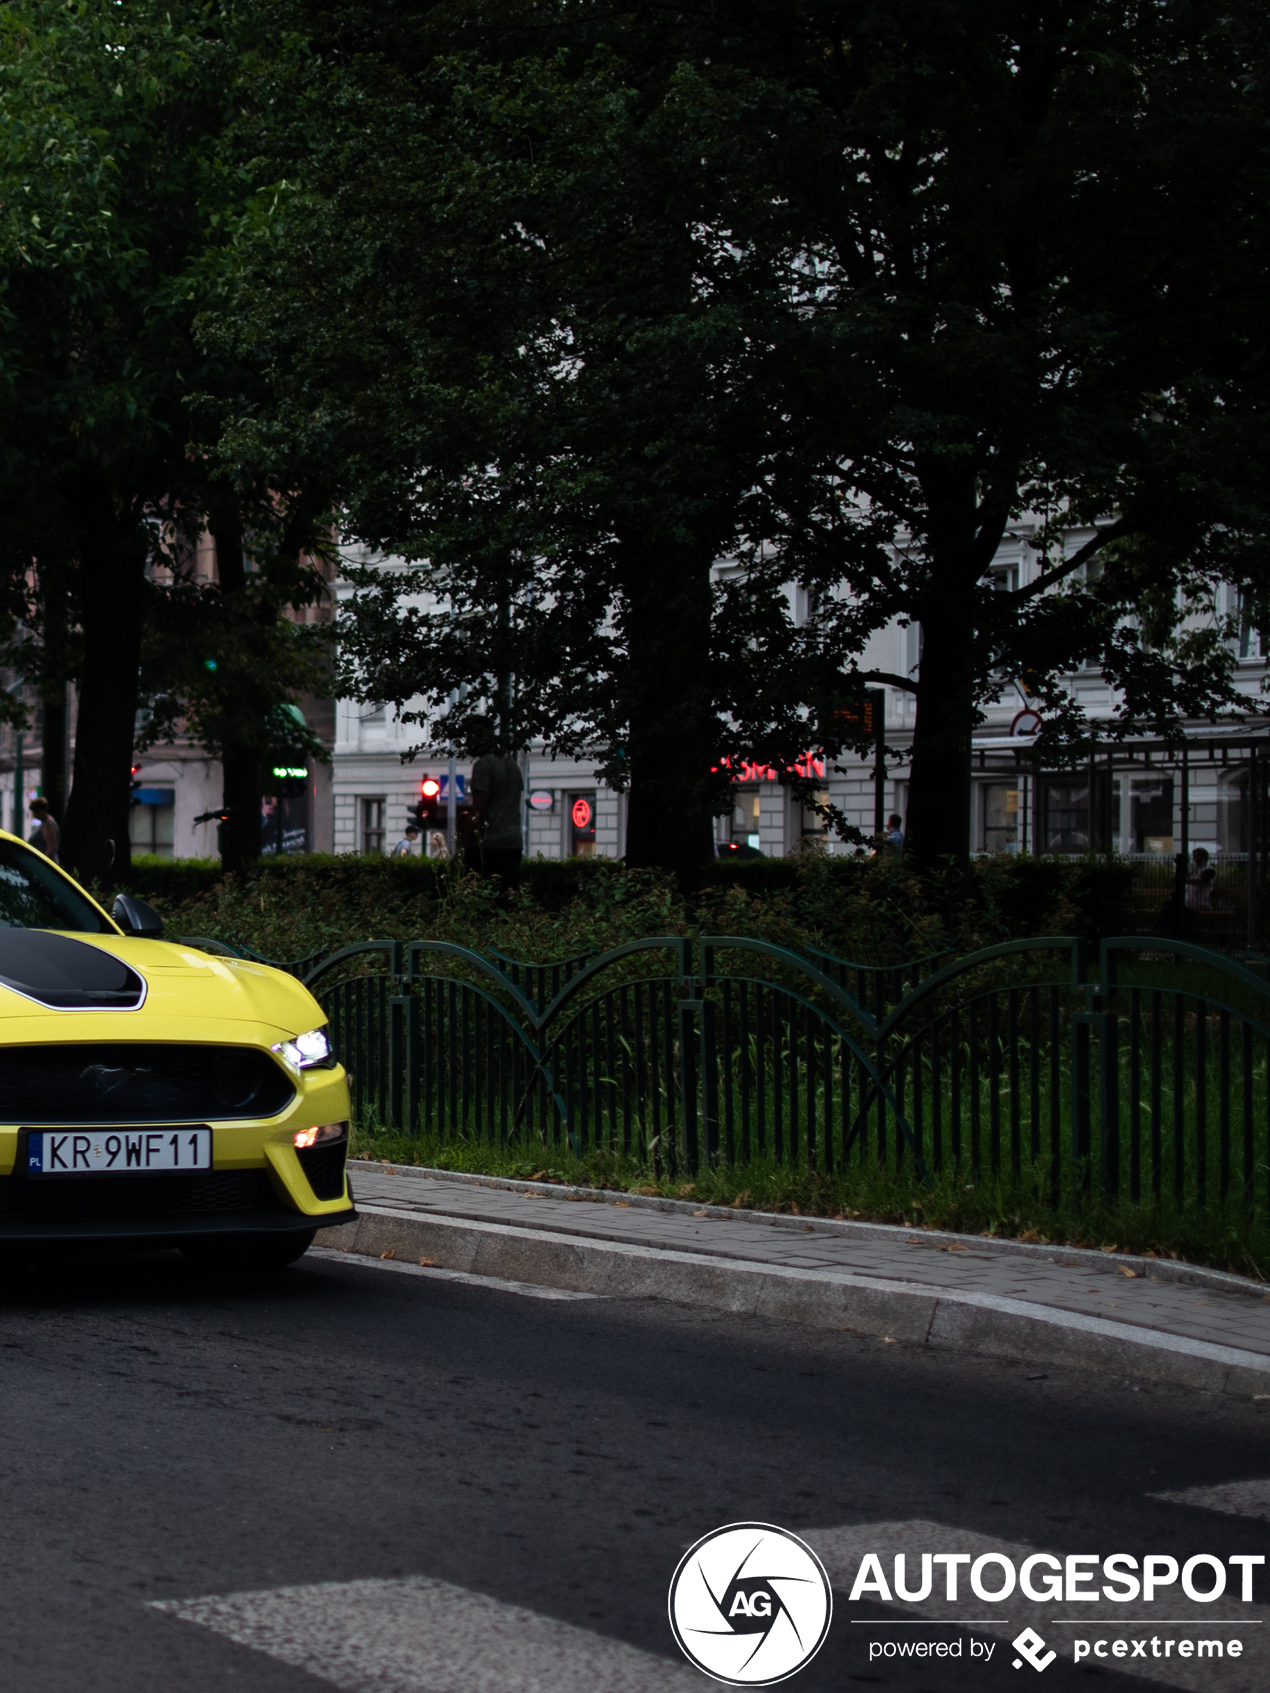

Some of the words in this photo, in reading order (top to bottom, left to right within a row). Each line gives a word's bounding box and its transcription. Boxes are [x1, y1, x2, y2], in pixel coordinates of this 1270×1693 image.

[30, 1157, 41, 1167] PL
[50, 1135, 91, 1169] KR
[105, 1133, 199, 1168] 9WF11
